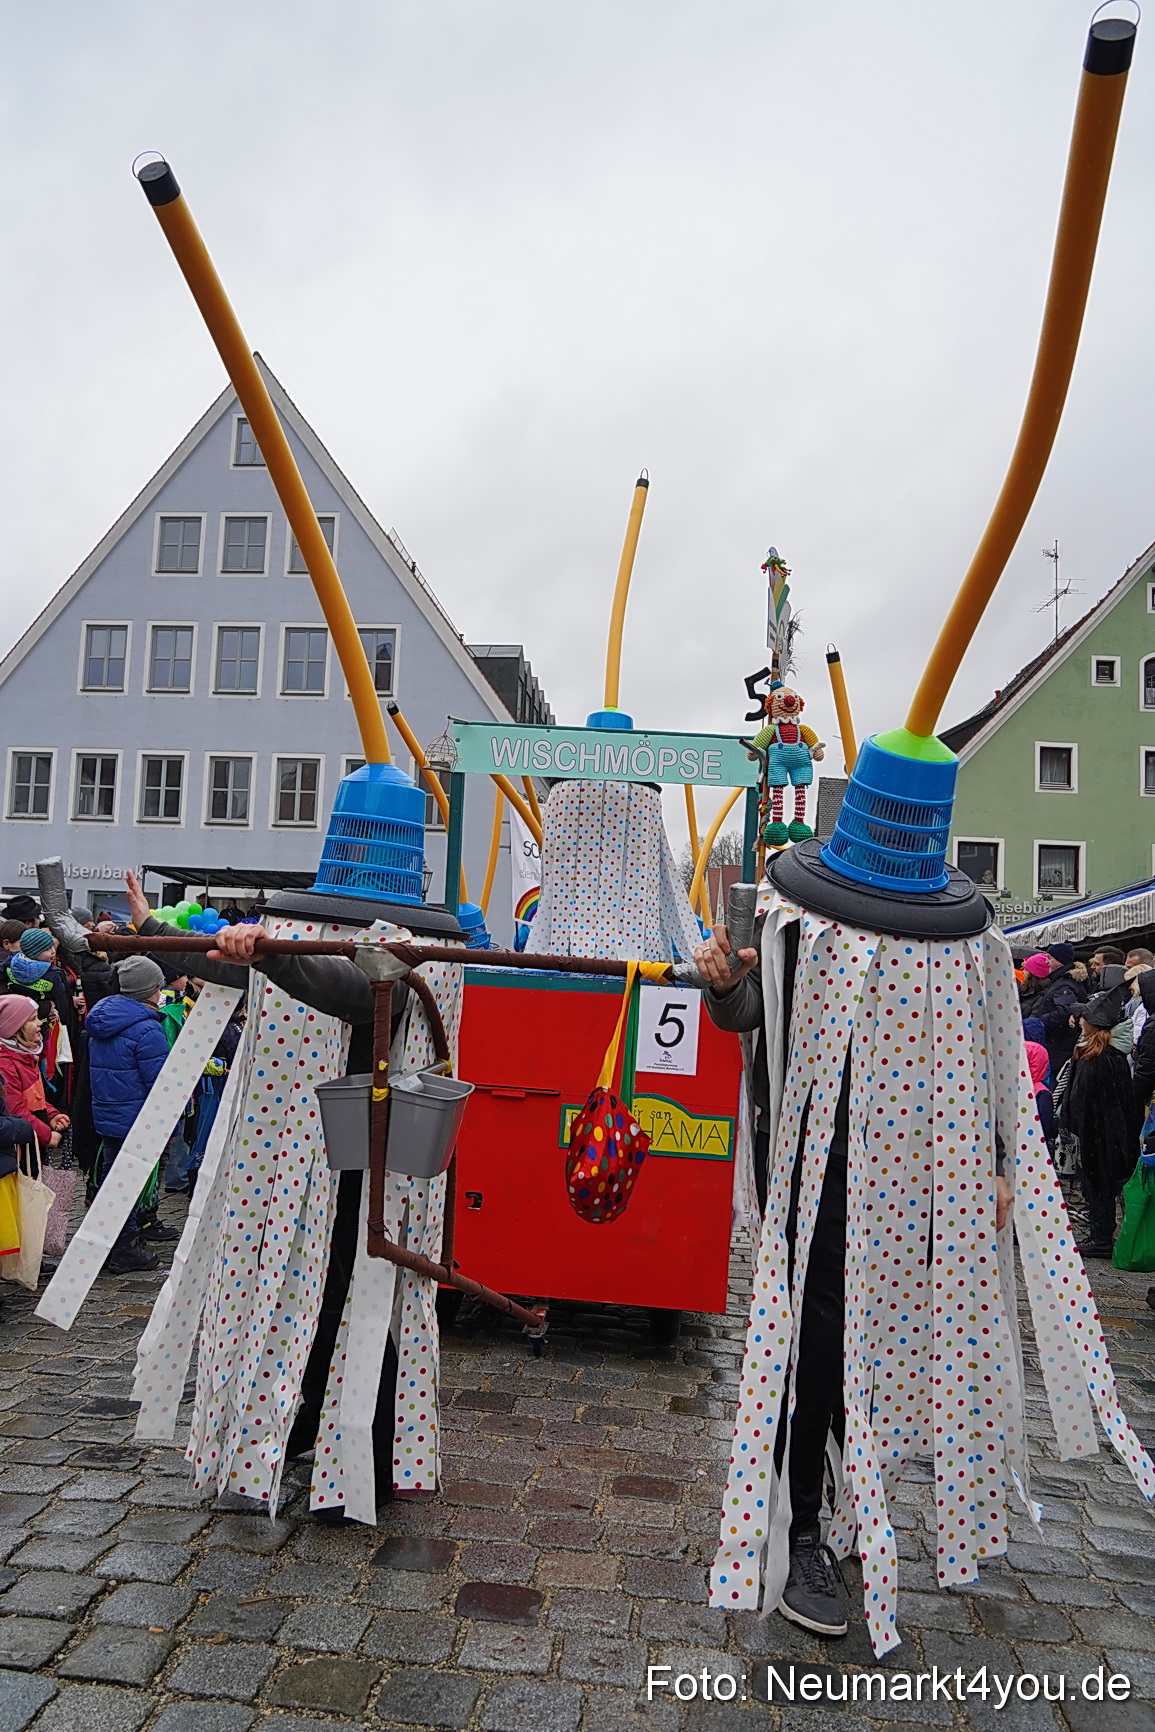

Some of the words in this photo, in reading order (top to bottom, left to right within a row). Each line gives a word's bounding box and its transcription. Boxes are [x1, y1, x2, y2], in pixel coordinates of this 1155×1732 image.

[744, 667, 771, 721] 5
[491, 736, 723, 780] WISCHMÖPSE
[655, 1003, 688, 1047] 5
[650, 1110, 673, 1120] san
